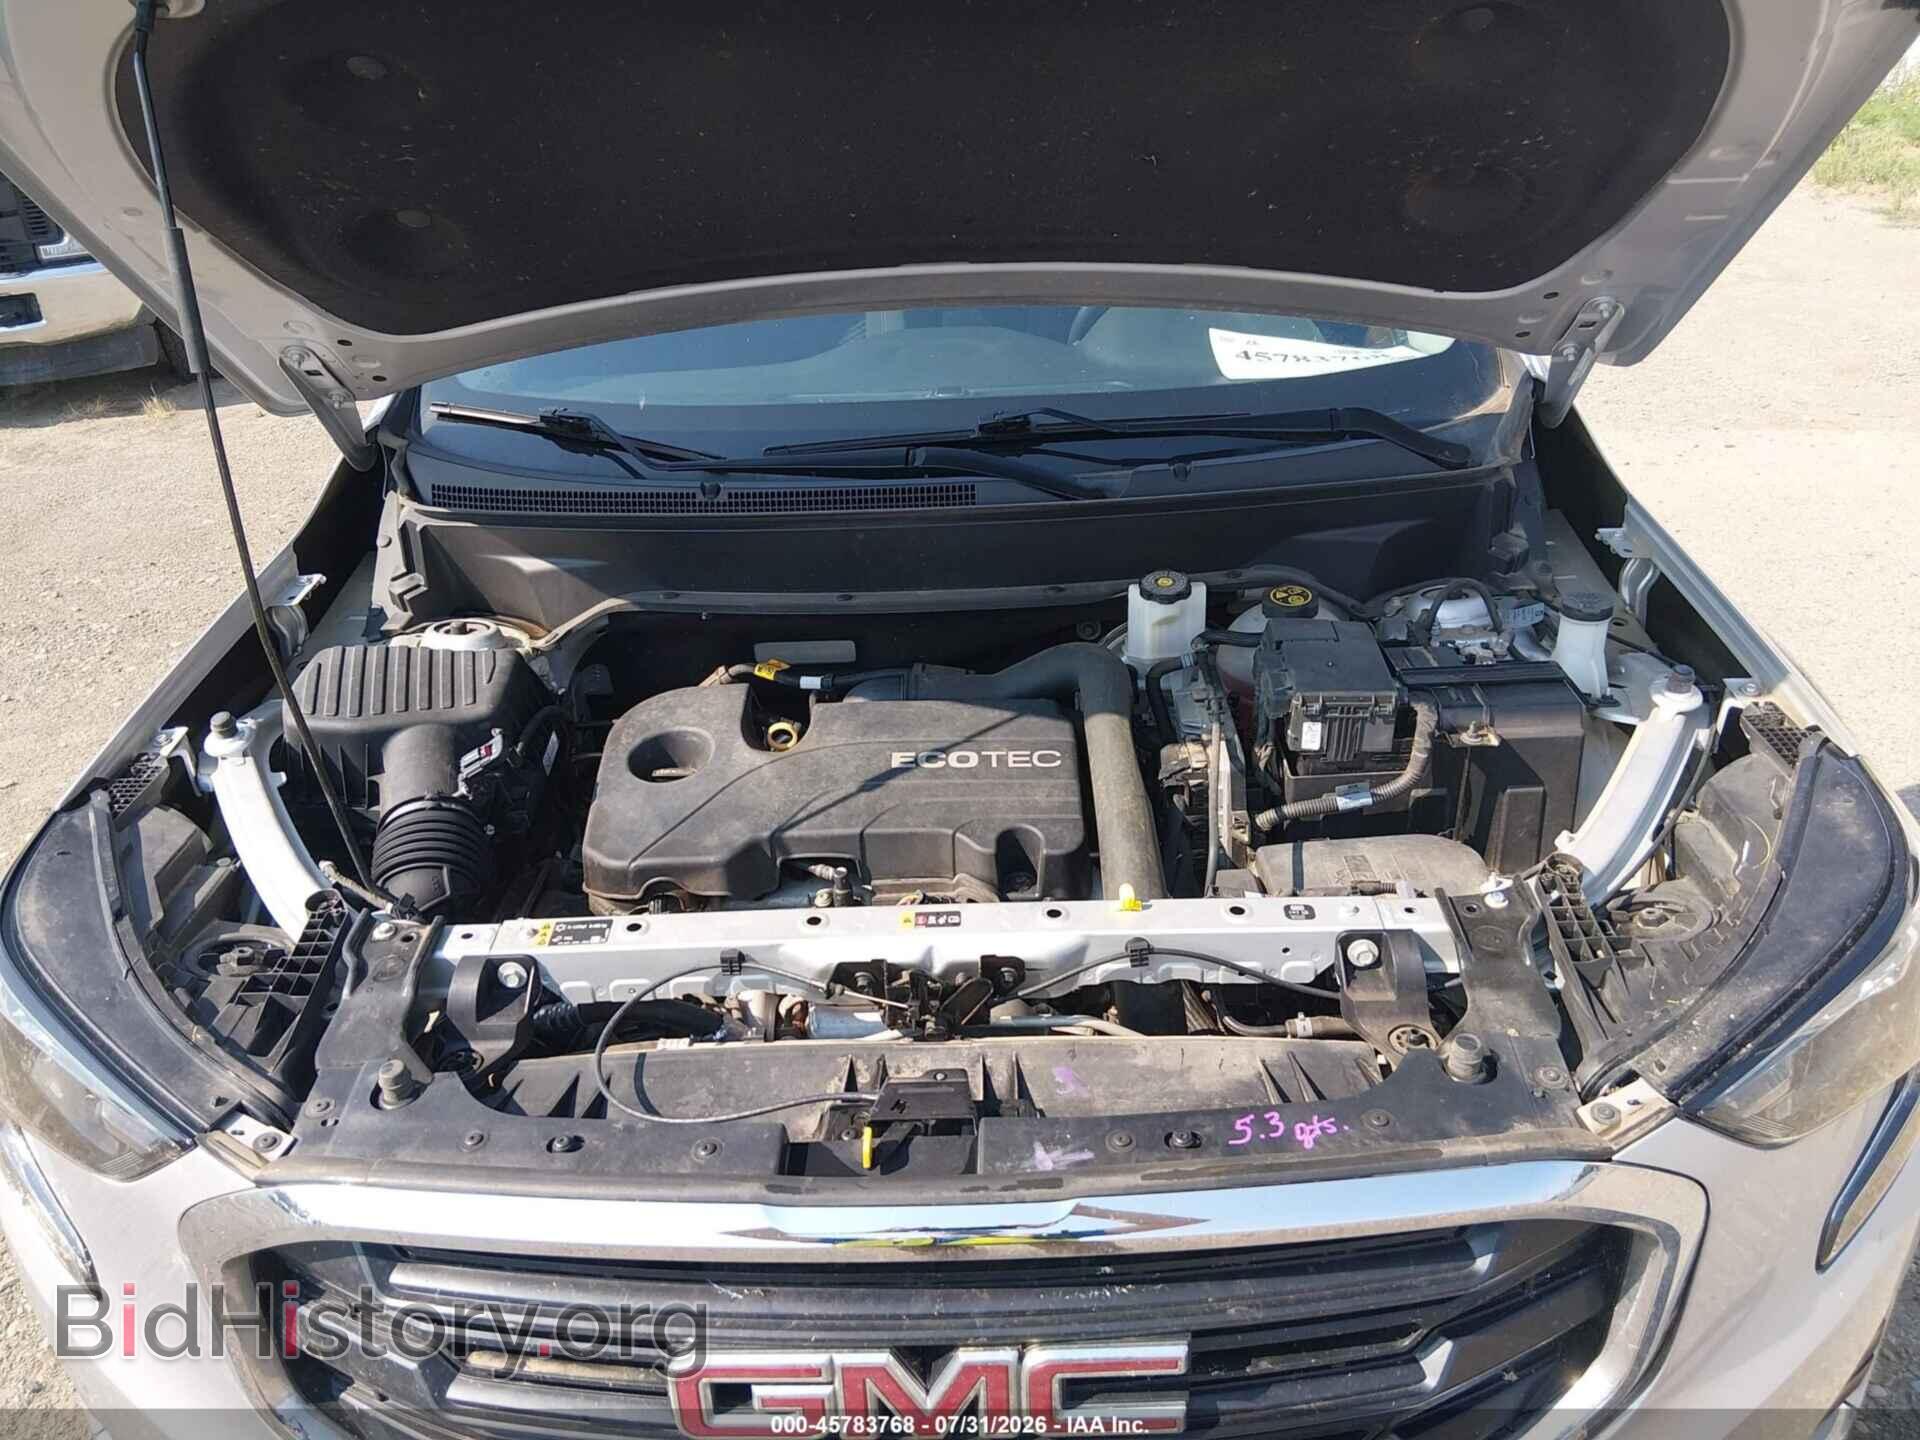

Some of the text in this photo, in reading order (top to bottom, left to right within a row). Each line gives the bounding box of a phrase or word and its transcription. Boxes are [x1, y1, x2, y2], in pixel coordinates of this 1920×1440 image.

[891, 750, 1062, 768] ECOTEC
[1228, 1111, 1285, 1145] 5.3
[668, 1342, 1190, 1438] GMC
